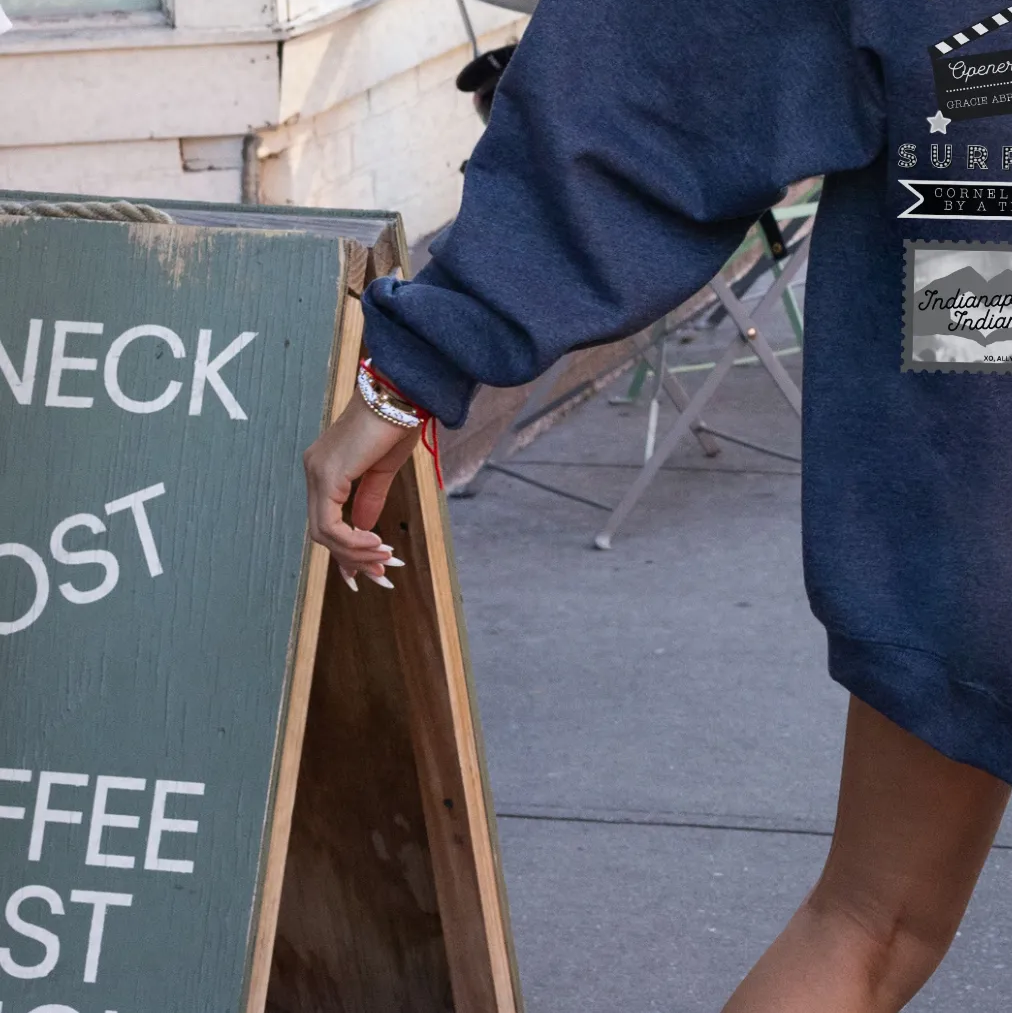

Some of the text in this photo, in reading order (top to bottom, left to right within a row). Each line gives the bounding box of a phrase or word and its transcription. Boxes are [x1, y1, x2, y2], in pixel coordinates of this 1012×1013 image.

[946, 96, 988, 110] GRACIE
[944, 200, 966, 212] BY
[977, 201, 987, 212] A
